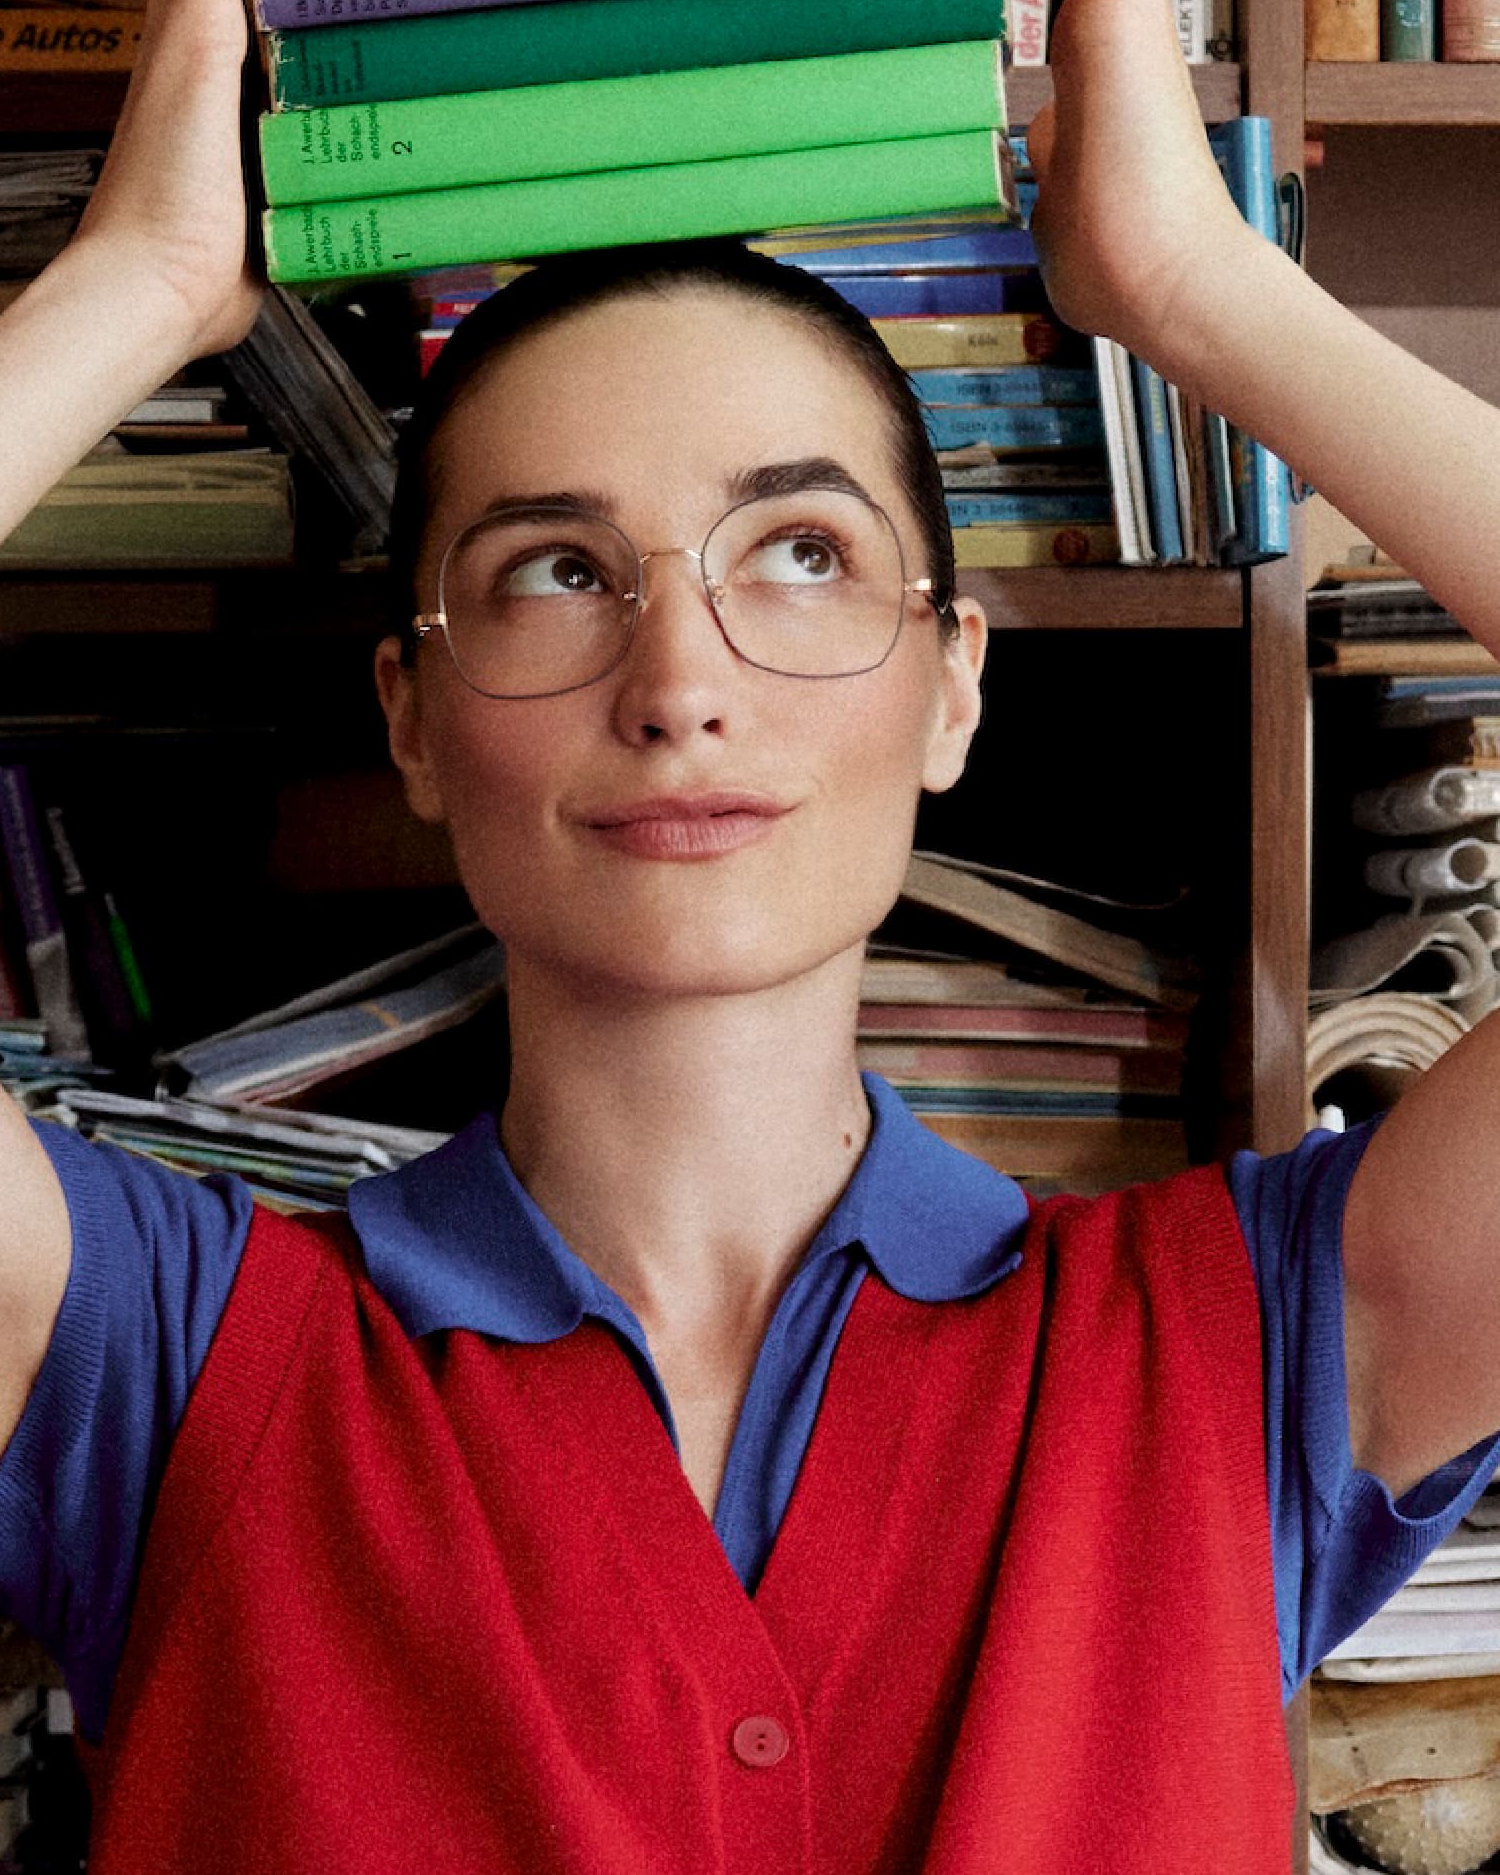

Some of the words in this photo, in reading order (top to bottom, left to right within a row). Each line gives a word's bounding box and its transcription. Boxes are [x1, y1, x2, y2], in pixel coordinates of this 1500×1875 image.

[12, 21, 123, 50] Autos
[1015, 15, 1042, 61] der
[392, 141, 412, 156] 2
[319, 216, 337, 273] Lehrbuch
[392, 252, 413, 261] 1
